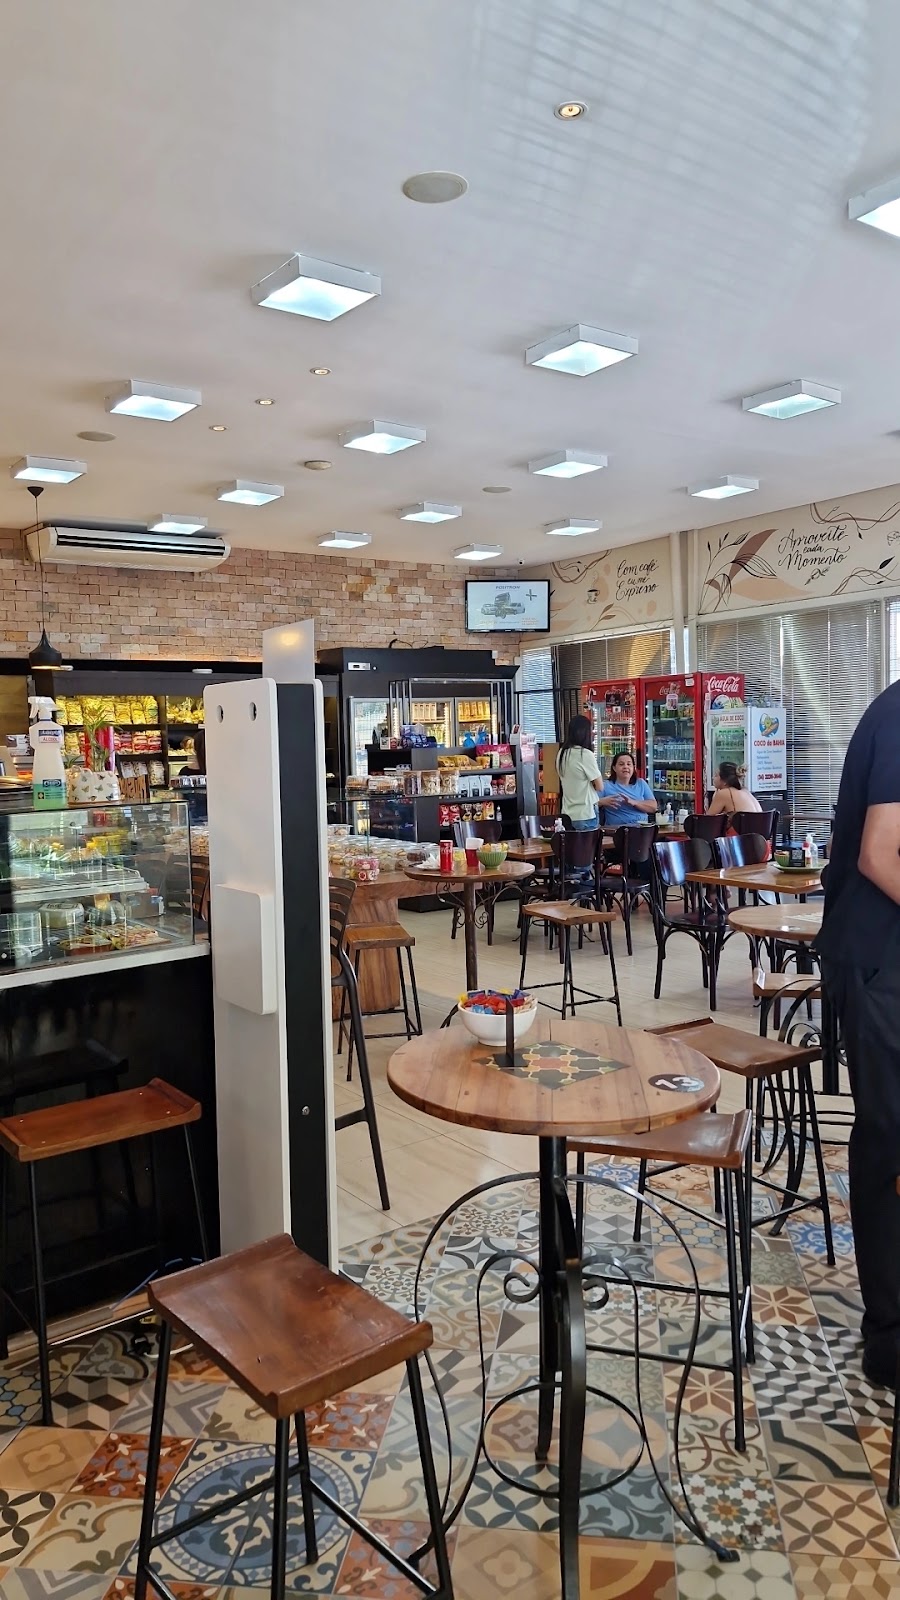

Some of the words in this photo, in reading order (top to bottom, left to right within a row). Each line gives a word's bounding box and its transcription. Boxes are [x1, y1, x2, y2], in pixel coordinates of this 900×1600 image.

[778, 524, 848, 554] Aproveite
[803, 543, 824, 554] cada
[616, 559, 638, 578] Com
[639, 559, 659, 576] café
[778, 545, 850, 571] Momento
[616, 580, 659, 602] Expresso
